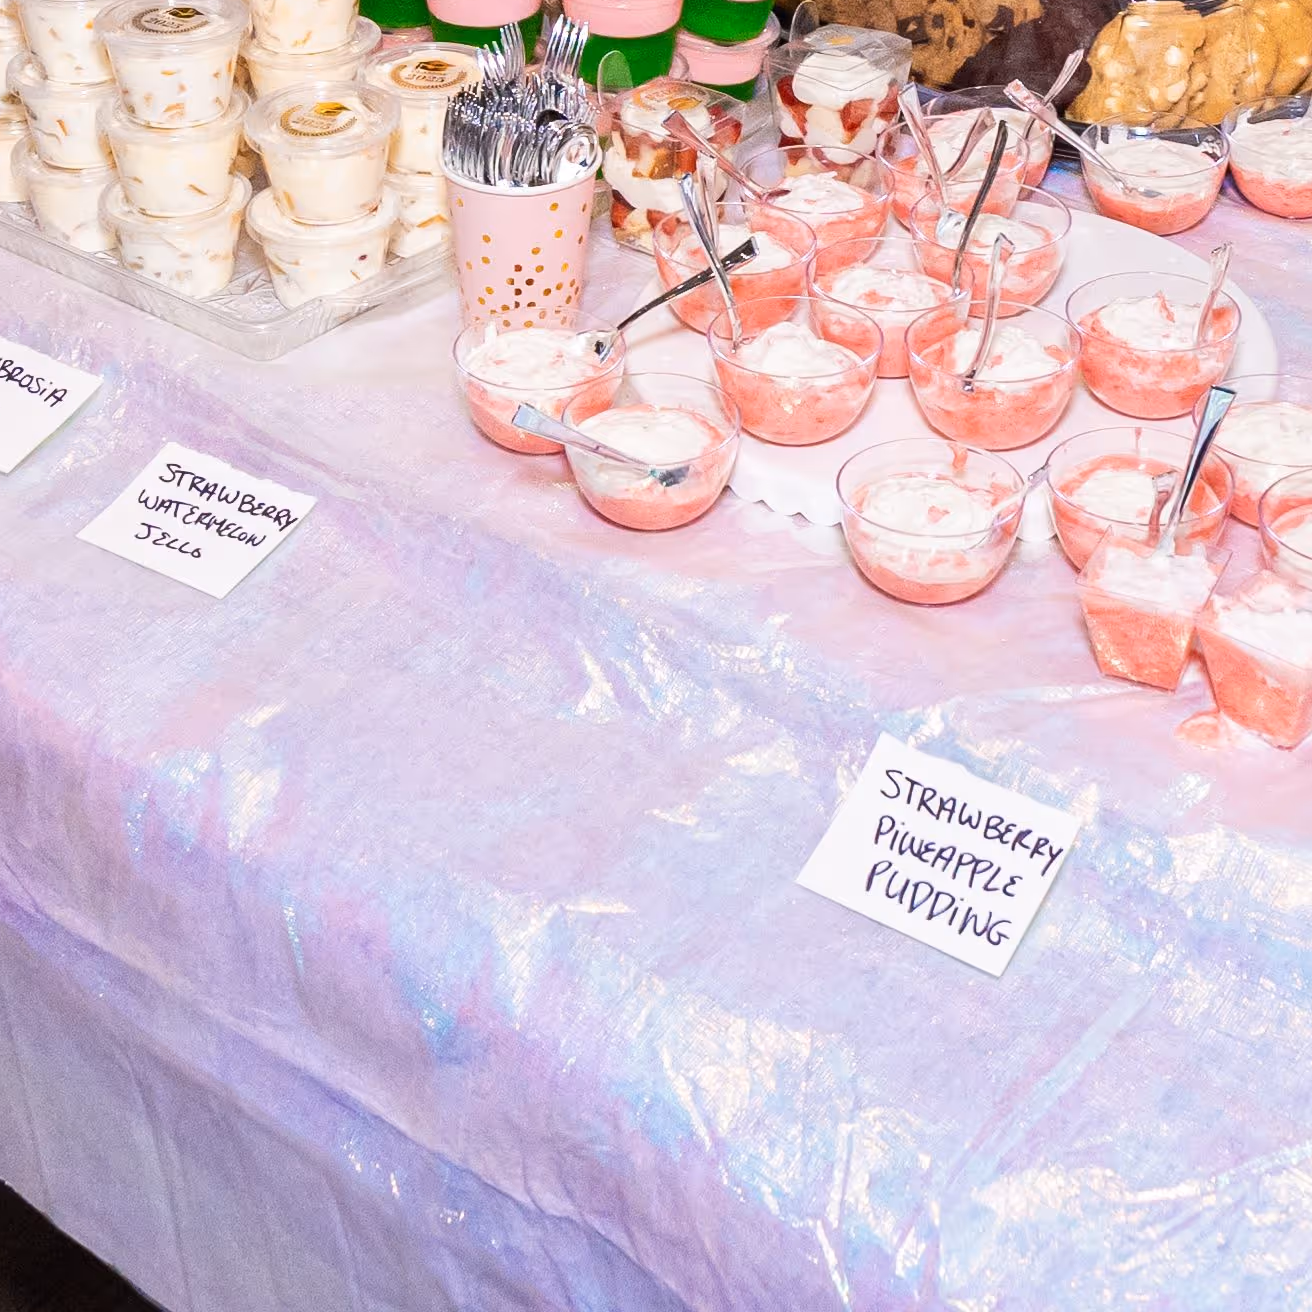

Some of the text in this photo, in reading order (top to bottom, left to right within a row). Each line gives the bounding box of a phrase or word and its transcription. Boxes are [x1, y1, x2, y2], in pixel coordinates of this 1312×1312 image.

[138, 489, 266, 547] WATERMELON
[159, 463, 298, 532] STRAWBERRY
[134, 522, 202, 559] JELLO
[880, 769, 1064, 876] STRAWBERRY
